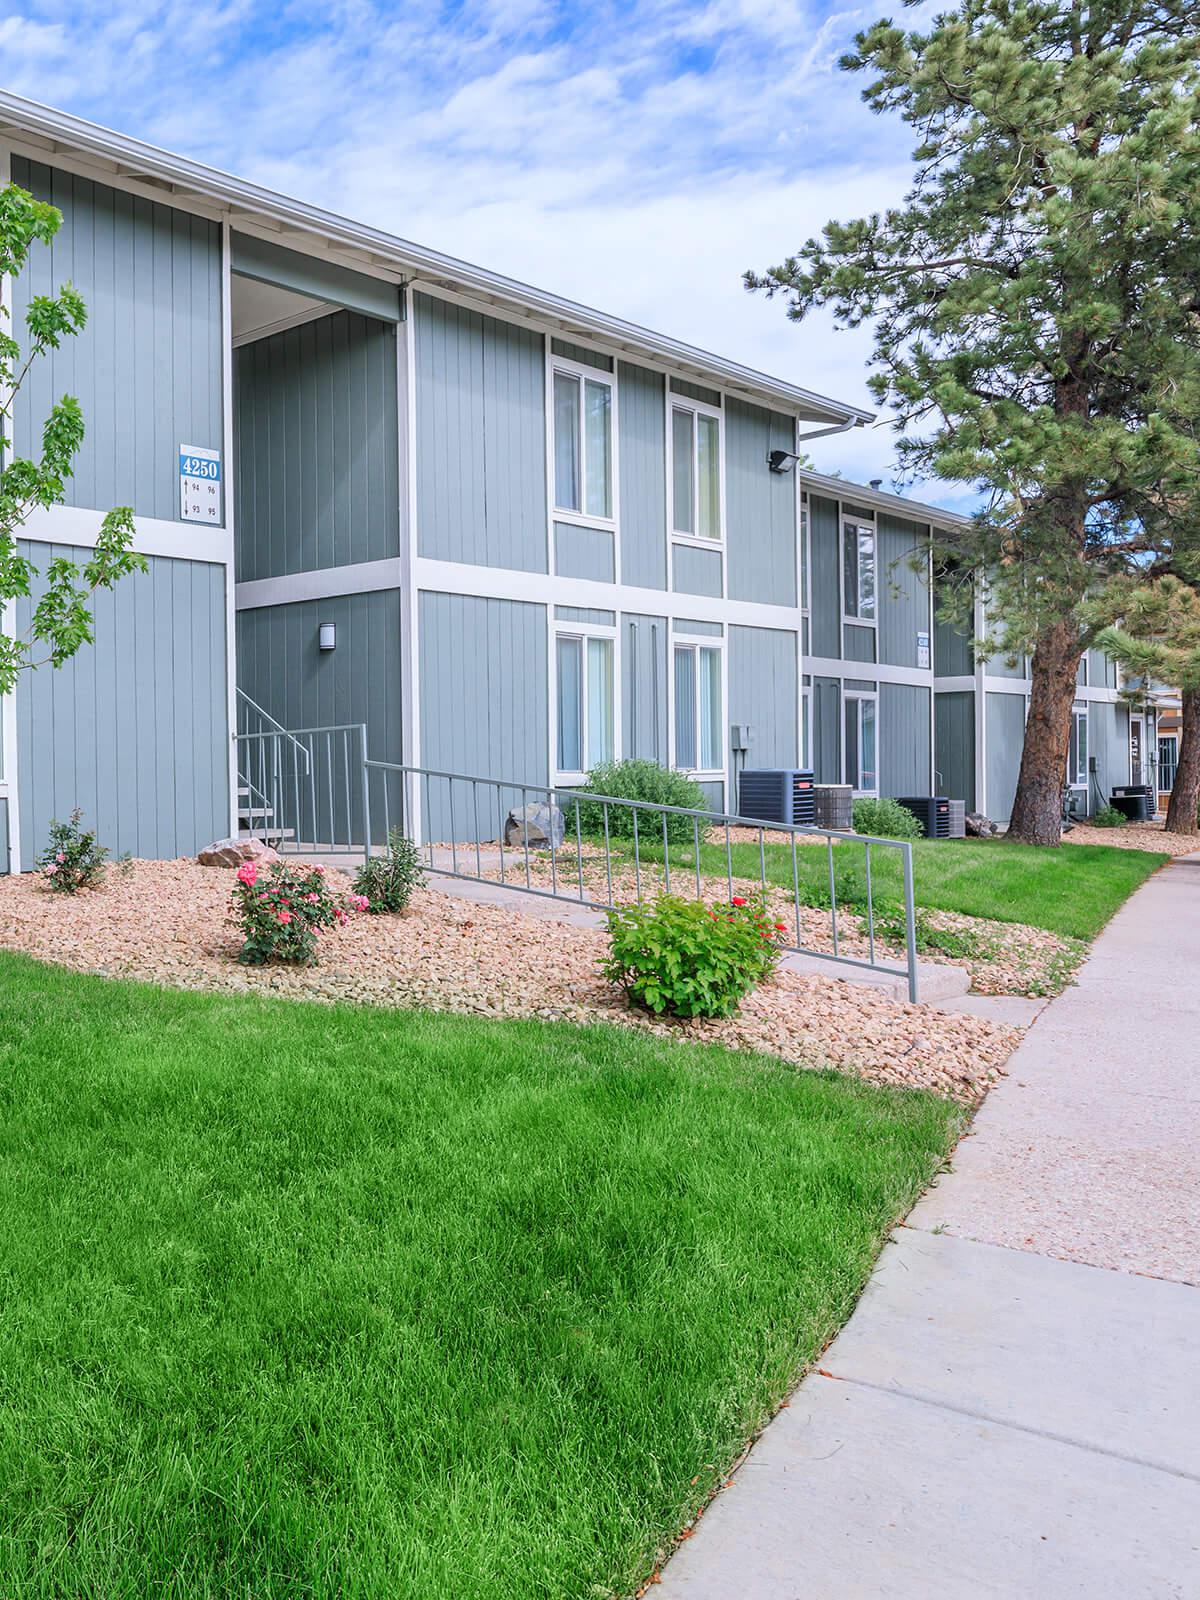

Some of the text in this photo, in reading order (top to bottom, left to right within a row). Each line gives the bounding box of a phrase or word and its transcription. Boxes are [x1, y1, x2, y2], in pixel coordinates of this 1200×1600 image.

[183, 457, 217, 479] 4250
[191, 483, 216, 495] 94 96
[192, 505, 216, 516] 93 95
